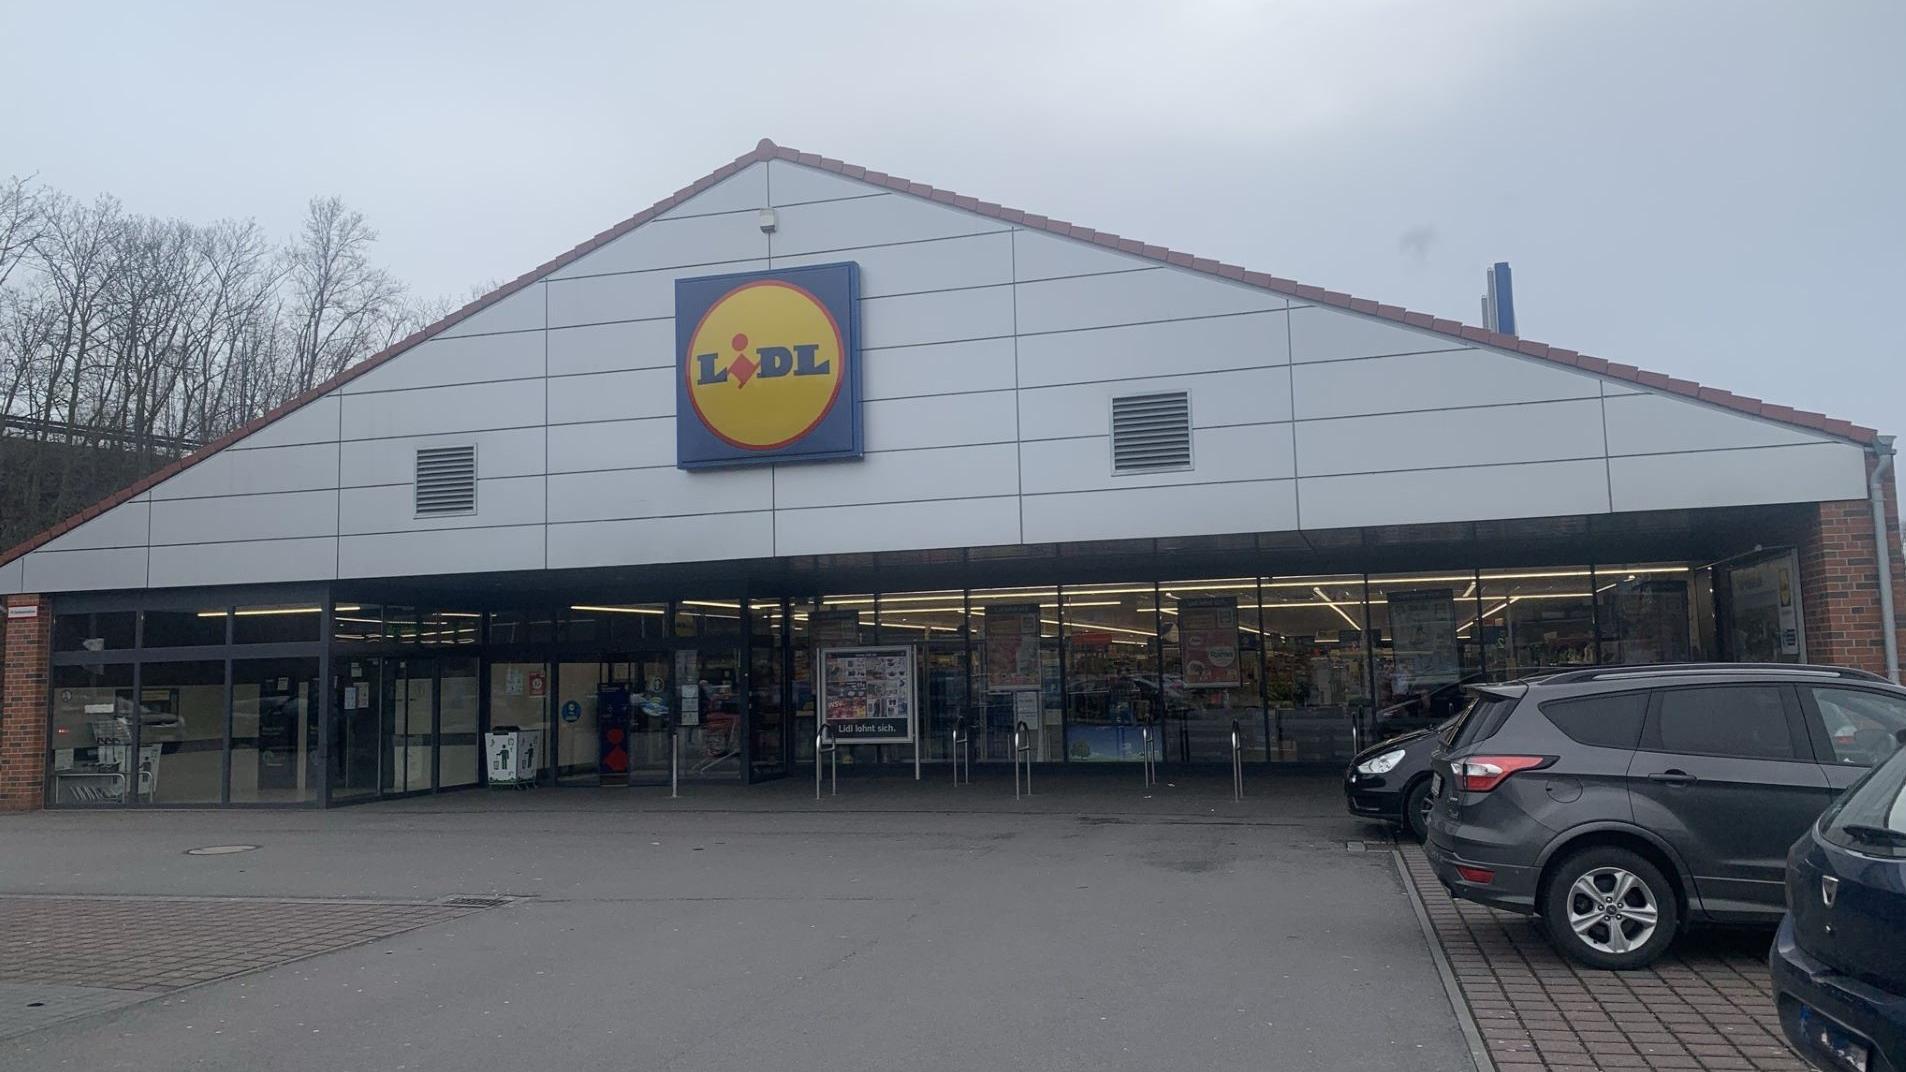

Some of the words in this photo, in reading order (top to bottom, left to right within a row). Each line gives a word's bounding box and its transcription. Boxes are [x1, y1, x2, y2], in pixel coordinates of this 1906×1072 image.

[838, 724, 854, 733] Lidl
[855, 724, 876, 733] lohnt
[877, 723, 897, 733] sich.
